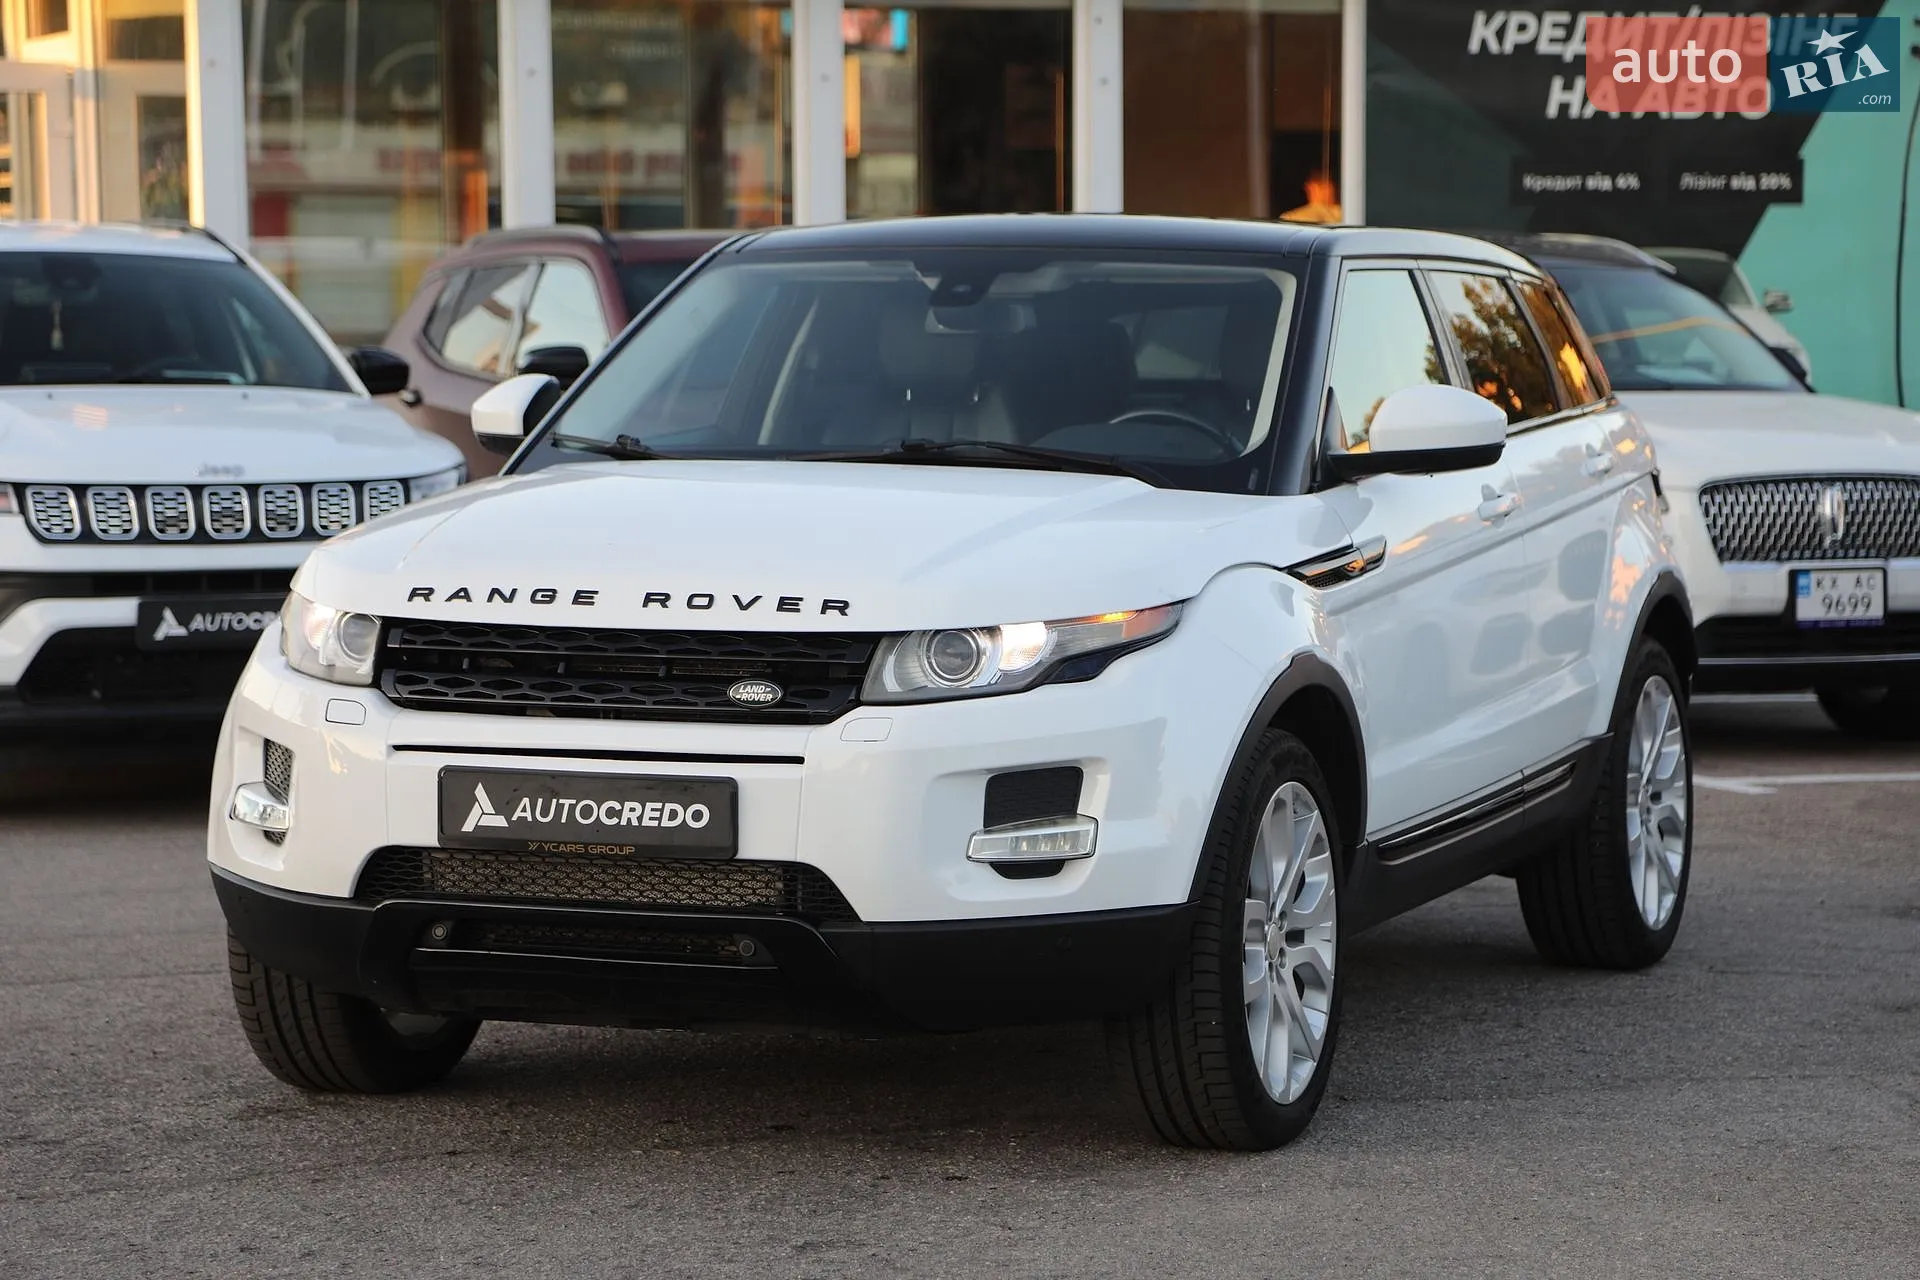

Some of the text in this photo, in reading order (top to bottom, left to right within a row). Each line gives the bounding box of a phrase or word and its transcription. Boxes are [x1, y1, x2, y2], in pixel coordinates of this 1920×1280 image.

[1545, 75, 1774, 120] НА АВТО
[407, 586, 852, 616] RANGE ROVER
[1821, 594, 1872, 616] 9699
[189, 610, 280, 633] AUTOCR
[738, 685, 766, 693] LAND
[740, 693, 773, 701] ROVER
[511, 797, 710, 828] AUTOCREDO
[588, 844, 636, 856] GROUP
